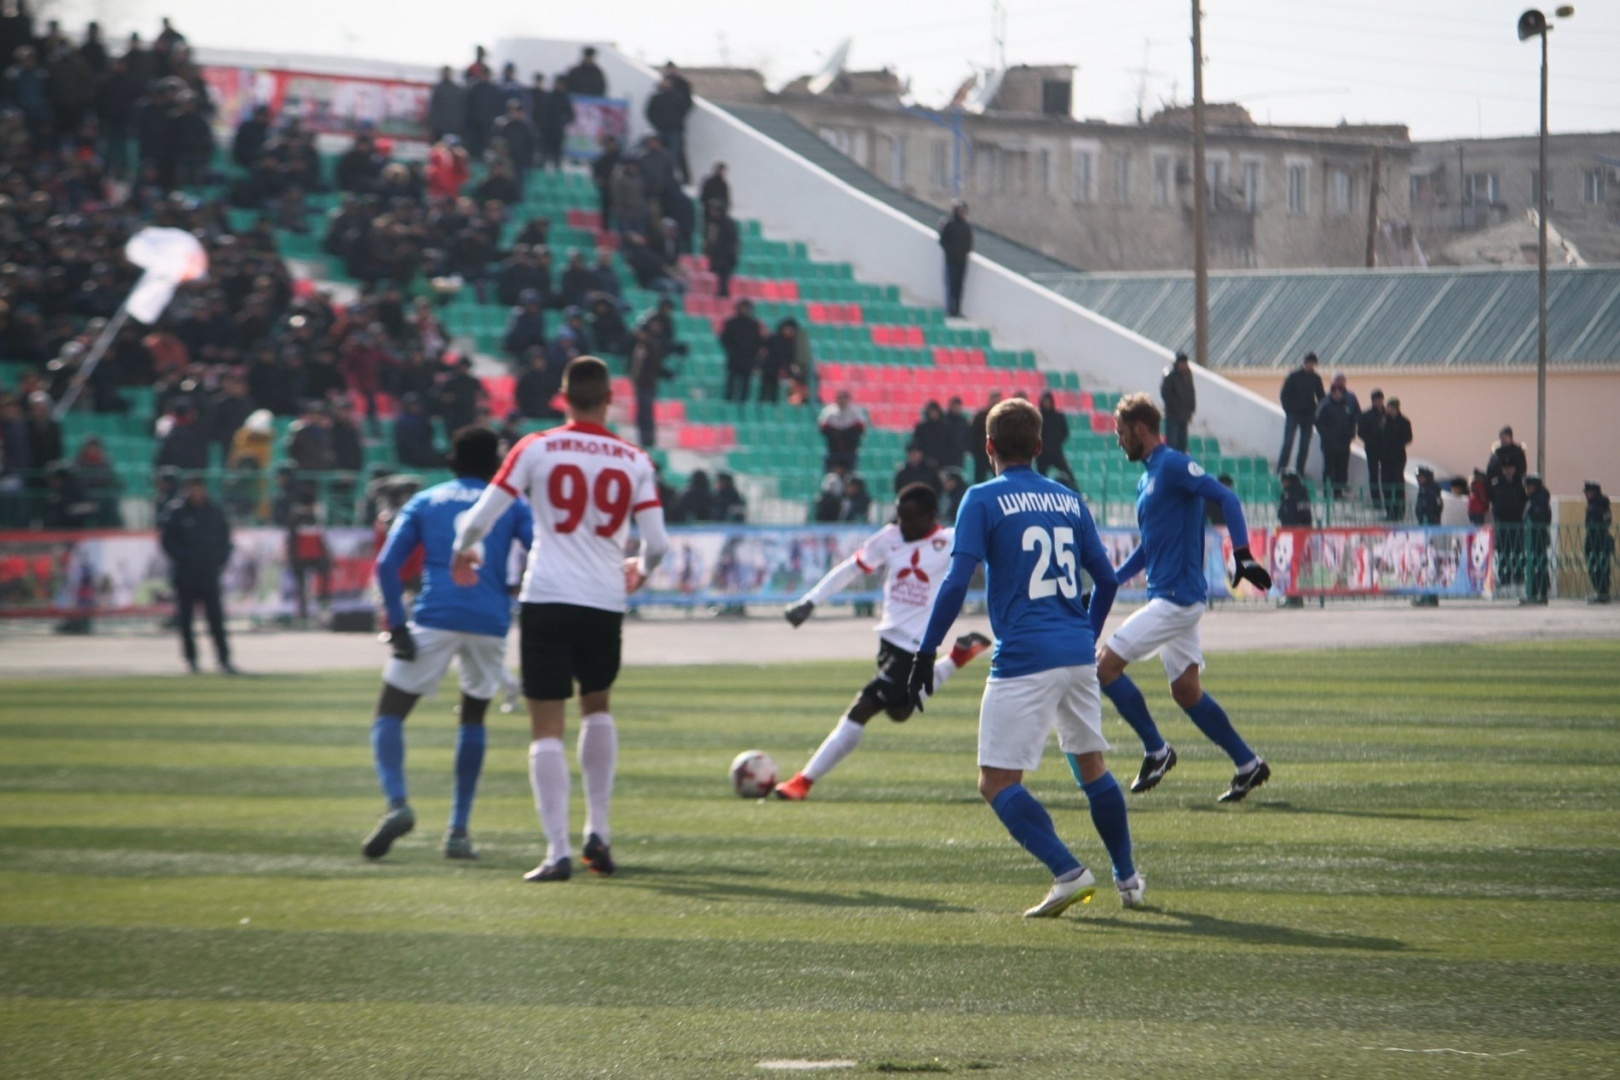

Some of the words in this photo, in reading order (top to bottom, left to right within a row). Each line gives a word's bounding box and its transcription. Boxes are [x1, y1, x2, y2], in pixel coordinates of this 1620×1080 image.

[547, 464, 632, 537] 99
[997, 492, 1080, 518] ШИПИЦИН
[1022, 525, 1077, 600] 25
